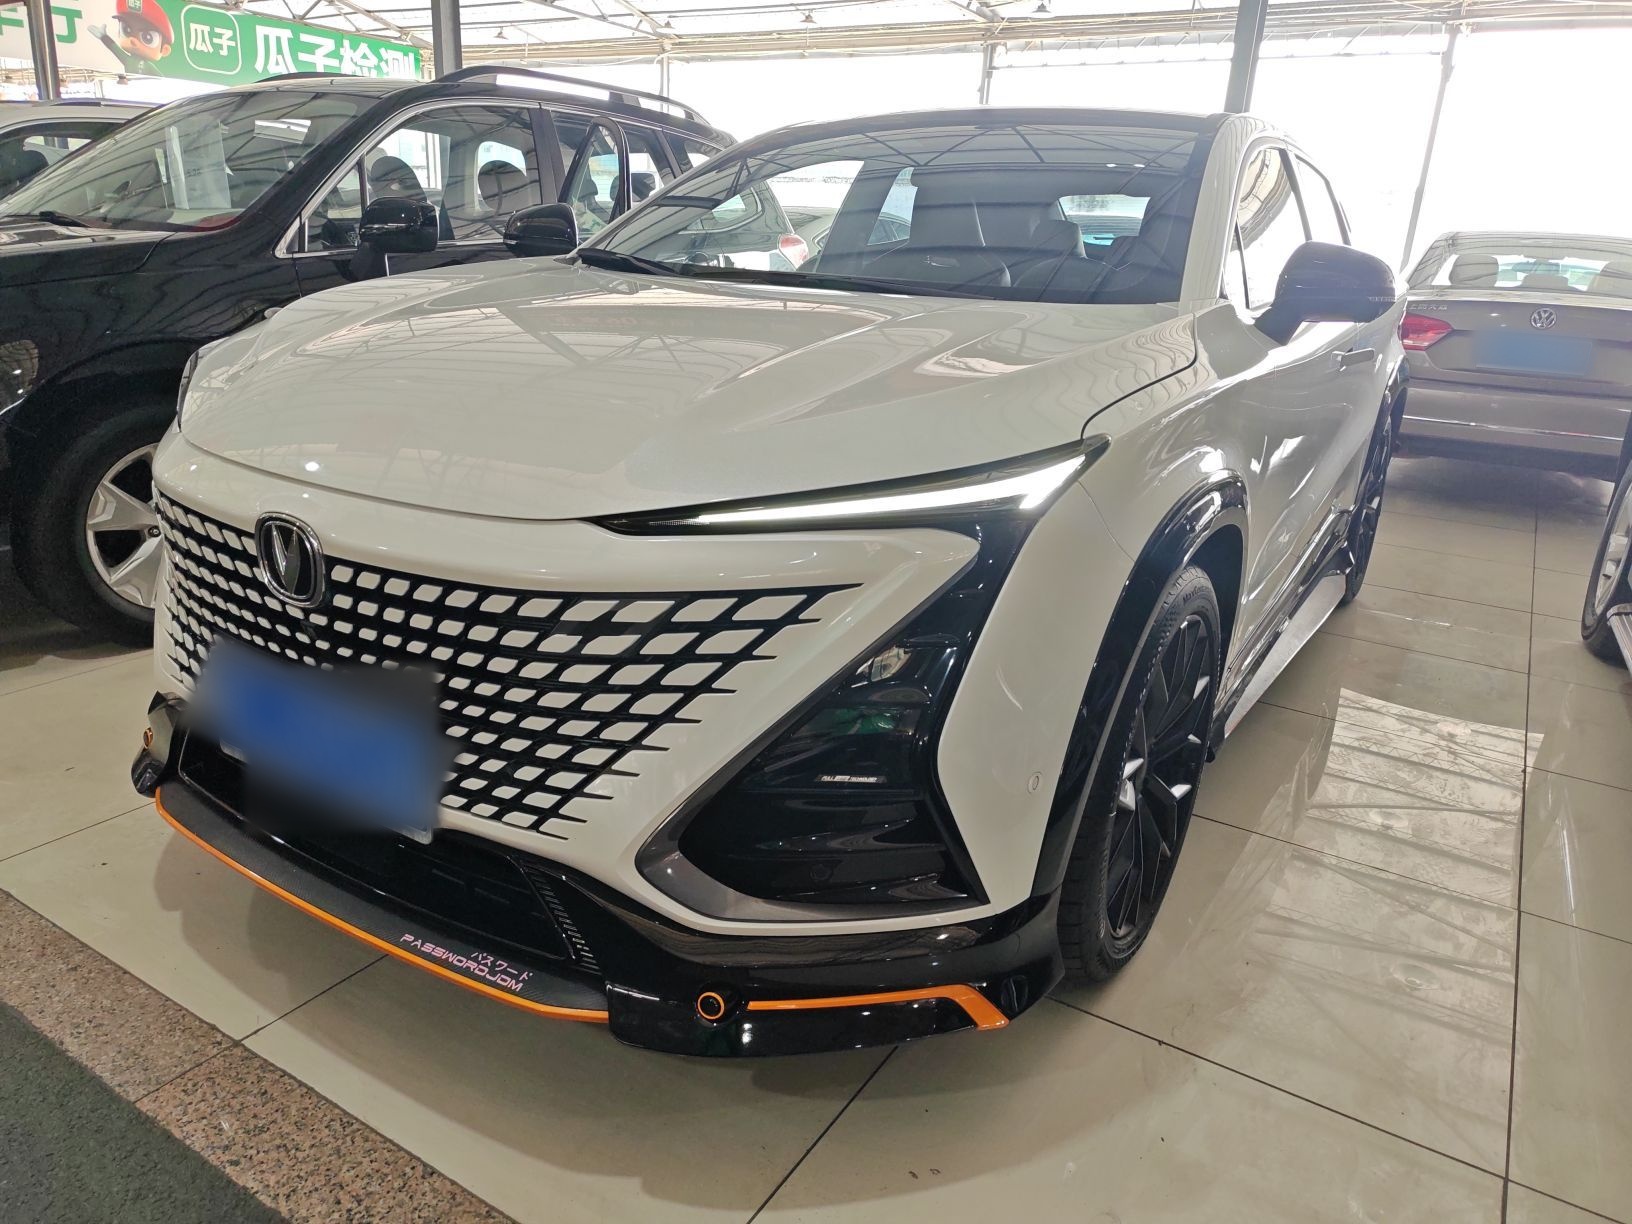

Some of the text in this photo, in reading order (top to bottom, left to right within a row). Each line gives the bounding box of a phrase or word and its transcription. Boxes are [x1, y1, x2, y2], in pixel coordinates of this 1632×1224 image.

[189, 22, 236, 56] 瓜子
[254, 24, 417, 78] 瓜子检测
[470, 952, 534, 981] パスワード
